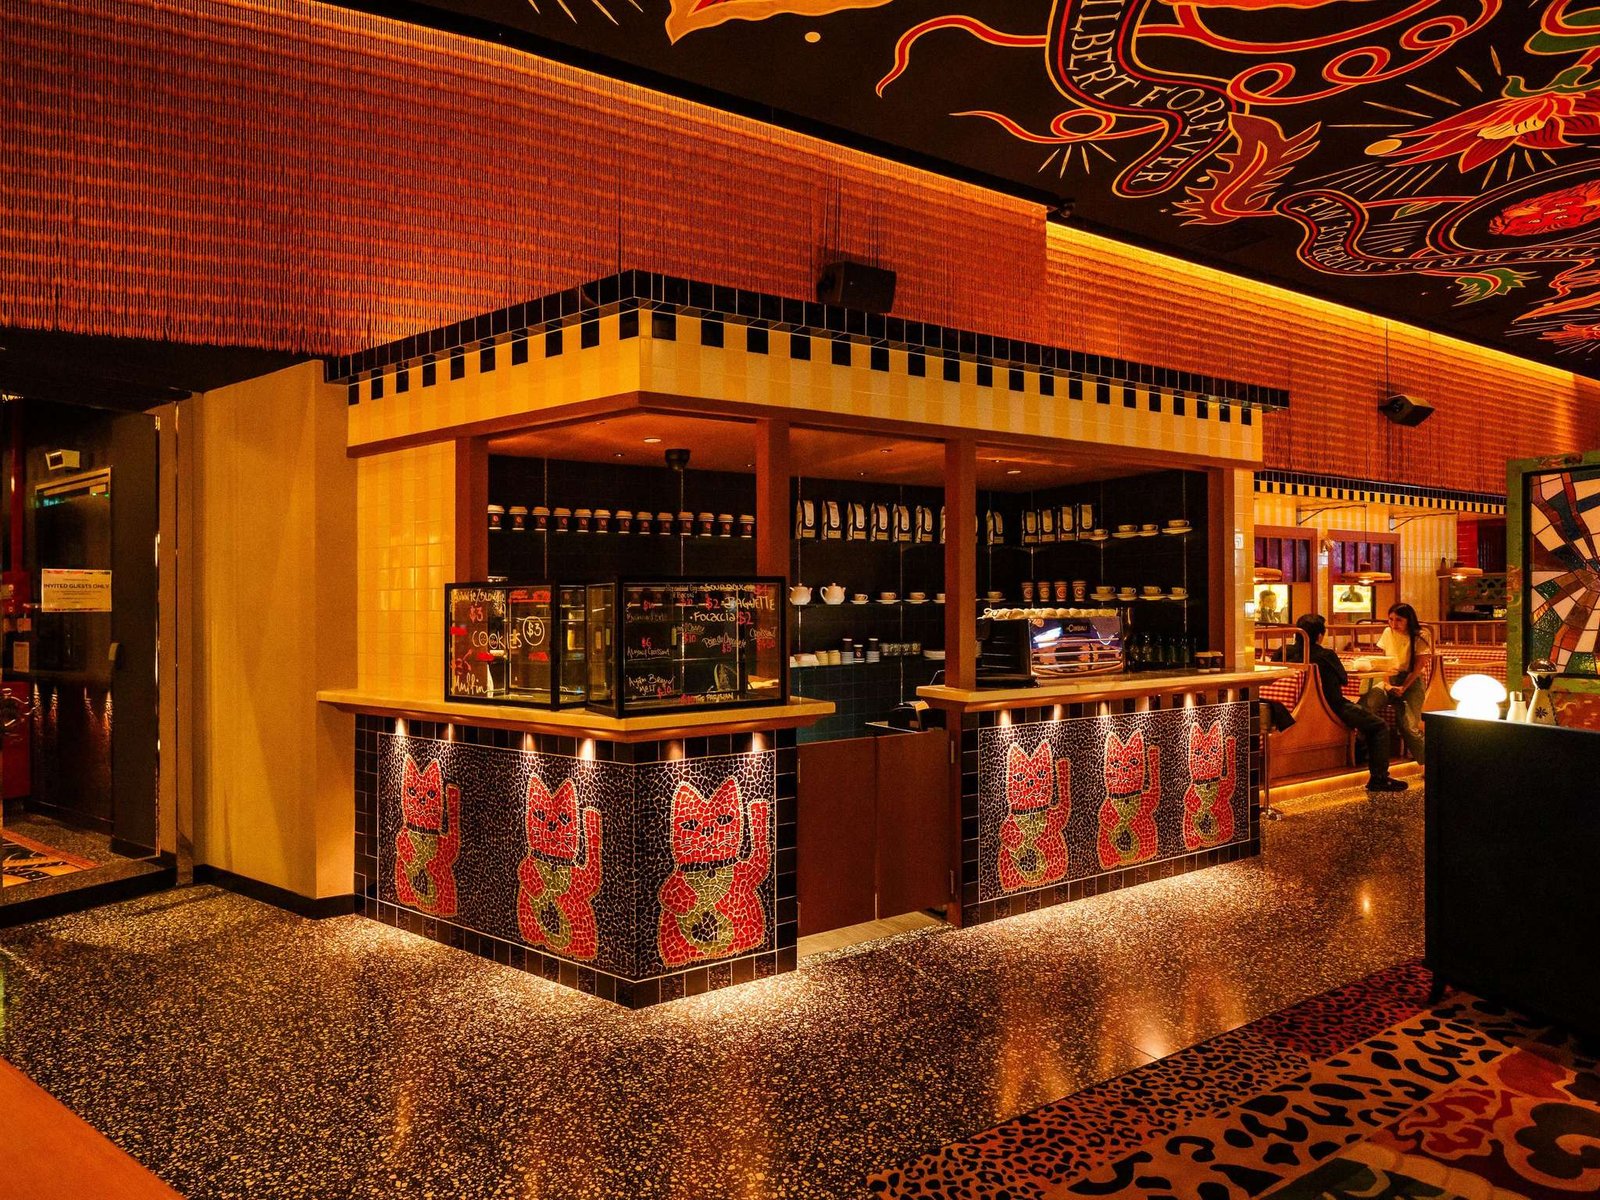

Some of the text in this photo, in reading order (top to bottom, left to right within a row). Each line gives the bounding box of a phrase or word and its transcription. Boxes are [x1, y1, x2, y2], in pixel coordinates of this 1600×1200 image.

[1129, 86, 1226, 185] FOREVER
[1290, 197, 1600, 272] THE BIRDS SURPRISE ME
[705, 594, 720, 609] $2
[469, 606, 484, 623] $3
[694, 611, 753, 625] Focaccia $2
[527, 621, 542, 638] $3
